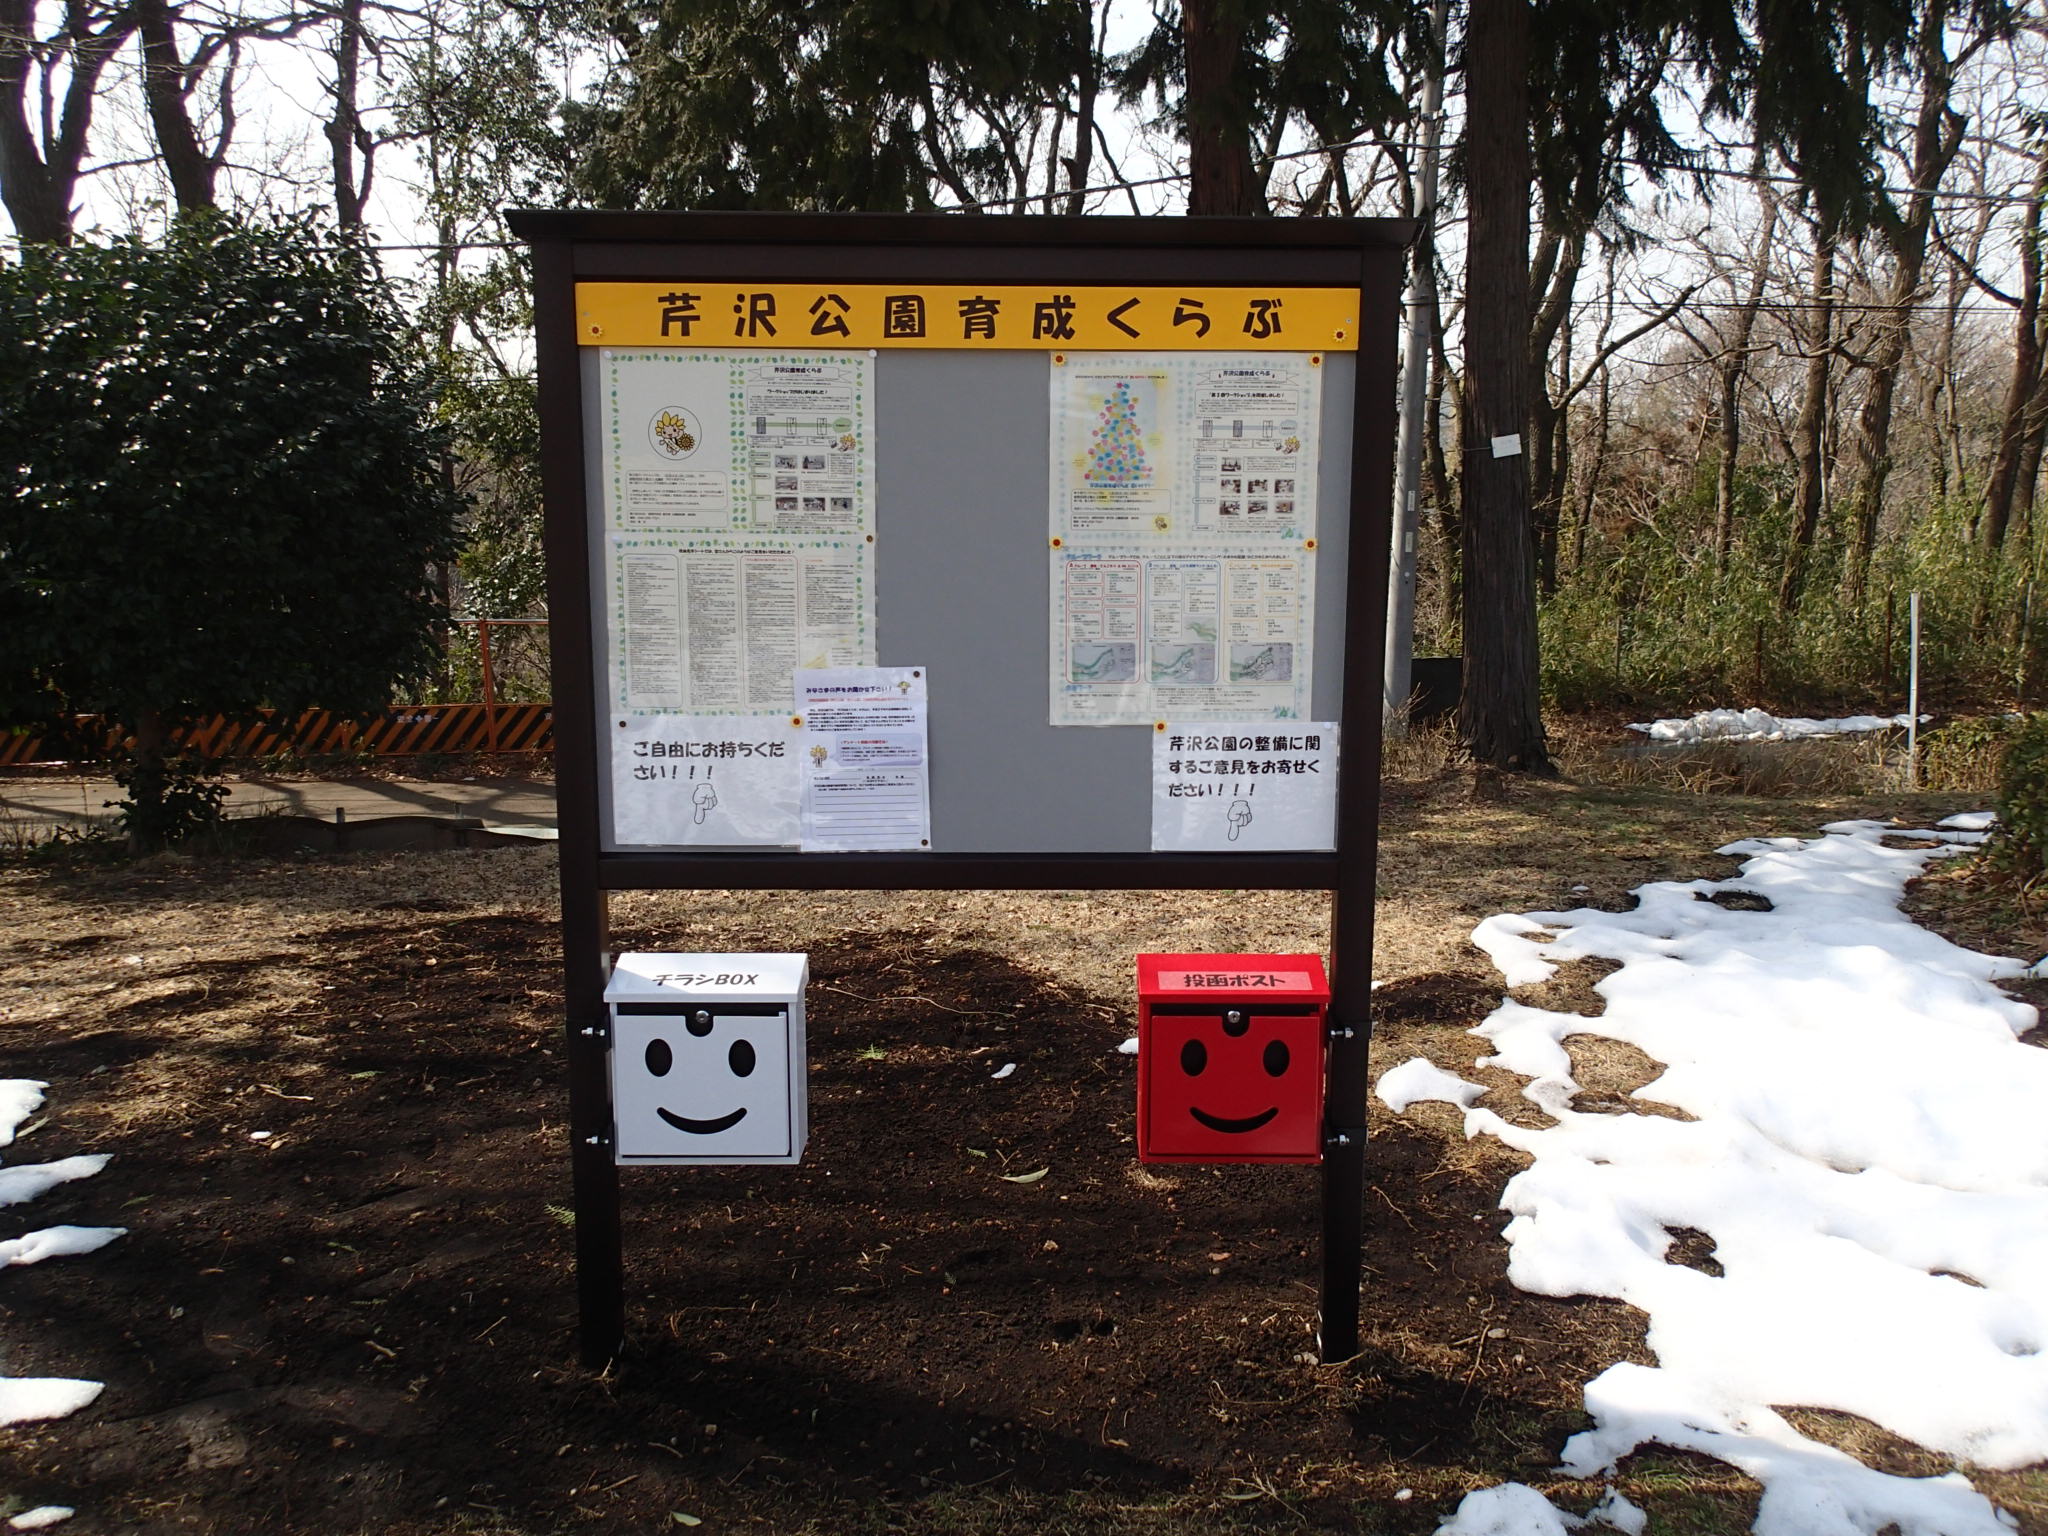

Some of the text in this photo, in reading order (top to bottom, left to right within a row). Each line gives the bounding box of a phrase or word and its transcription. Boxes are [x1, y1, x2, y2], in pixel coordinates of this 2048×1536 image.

[658, 292, 1283, 340] 芹沢公園育成くらぶ
[633, 741, 785, 758] ご自由にお持ちくだ
[1169, 735, 1321, 751] 芹沢公園の整備に関
[1168, 759, 1320, 775] するご意見をお寄せく
[652, 973, 760, 986] チラシBOX
[1183, 973, 1286, 988] 投函ポスト
